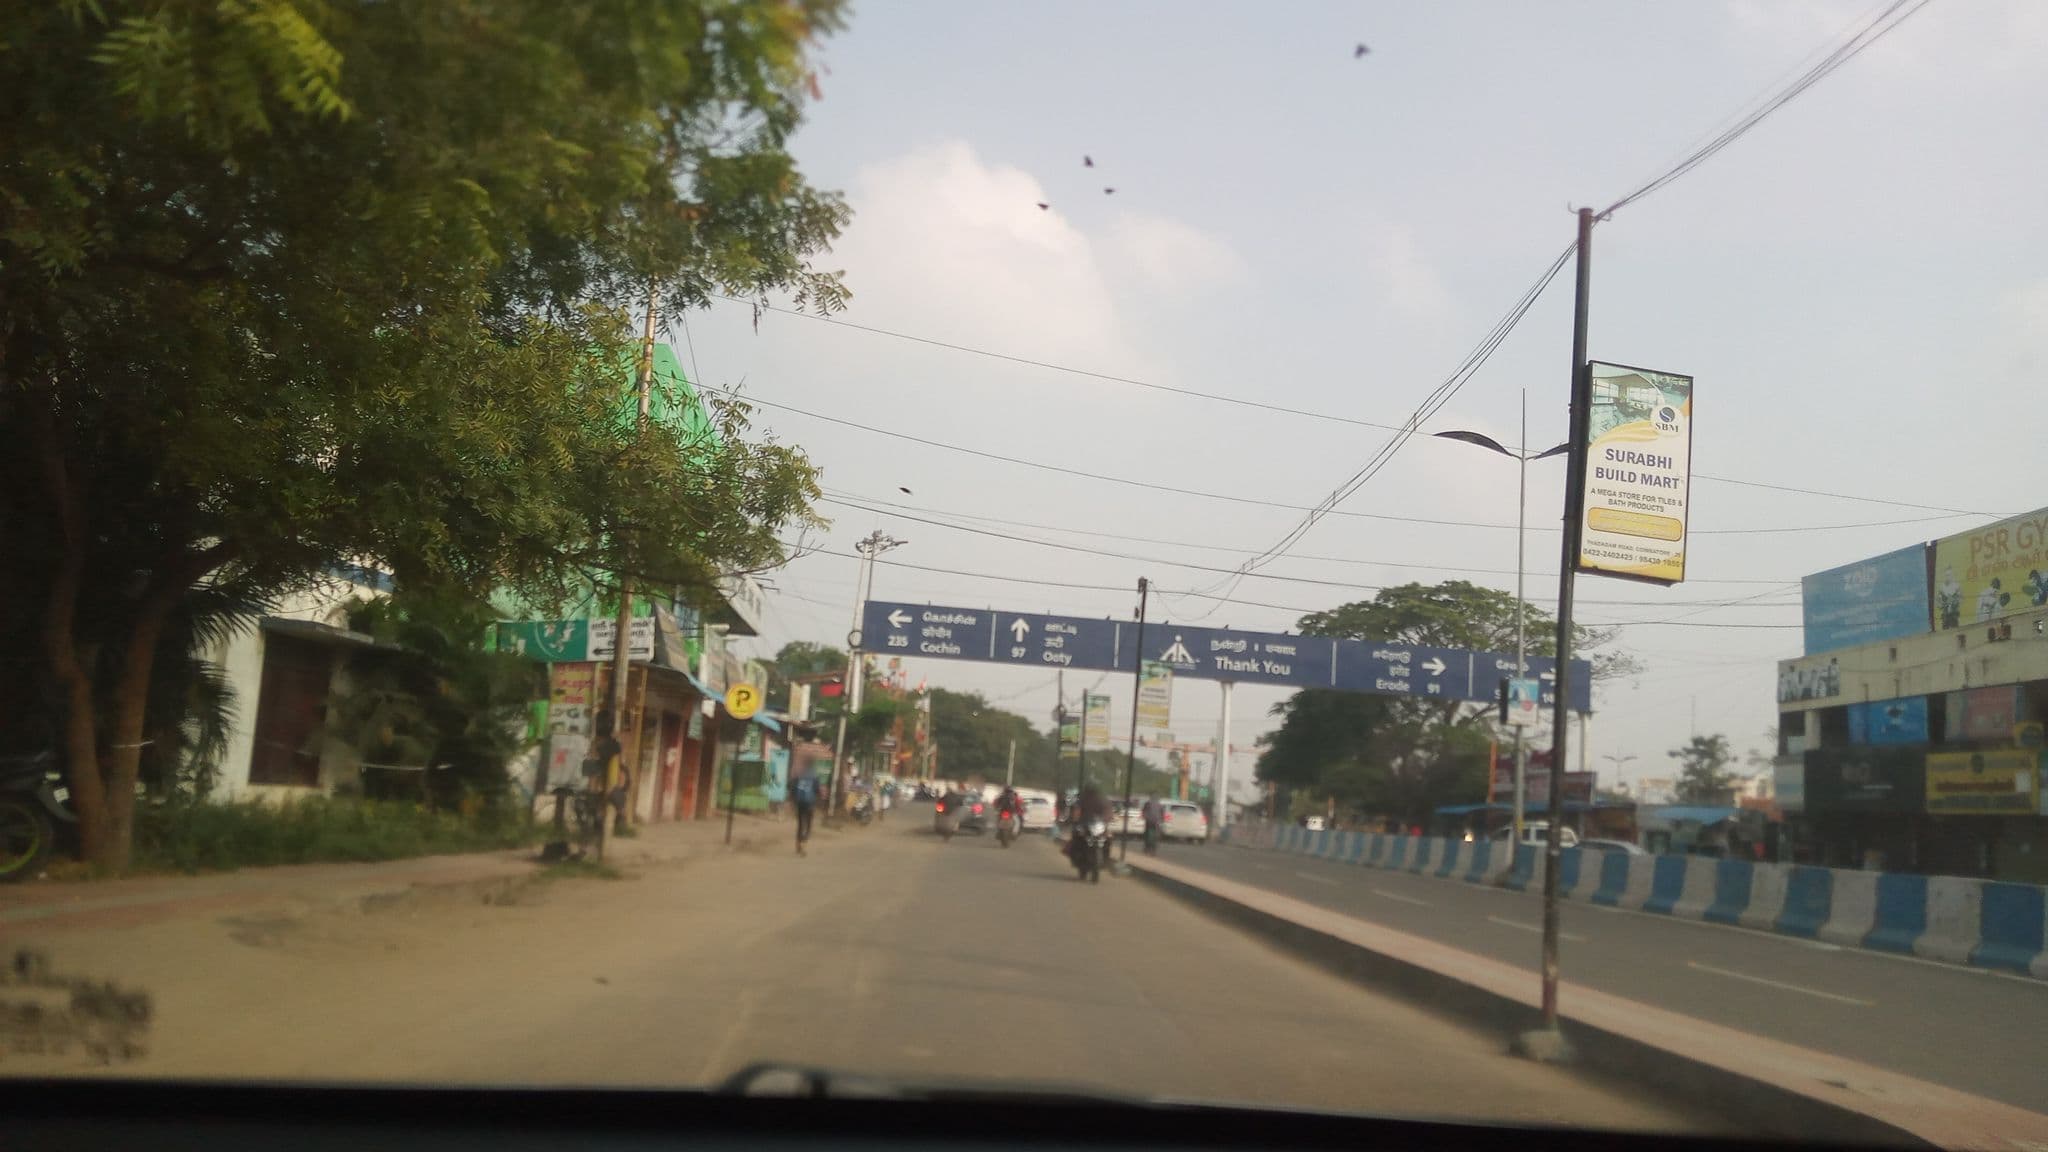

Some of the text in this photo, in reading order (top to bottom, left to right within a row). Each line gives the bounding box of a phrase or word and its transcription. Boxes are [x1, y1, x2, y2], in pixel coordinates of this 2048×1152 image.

[1656, 422, 1679, 433] SBM
[1605, 448, 1672, 469] SURABHI
[1595, 466, 1680, 489] BUILD MART
[1597, 488, 1617, 497] MEGA
[1618, 491, 1641, 501] STORE
[1642, 494, 1657, 503] FOR
[1658, 496, 1676, 506] TILES
[1608, 498, 1665, 513] BATH PRODUCTS
[1968, 528, 2009, 562] PSR
[920, 641, 961, 655] Cochin
[1043, 651, 1072, 666] Ooty
[1215, 655, 1291, 675] Thank You
[1376, 679, 1410, 692] Erode
[734, 690, 750, 708] P
